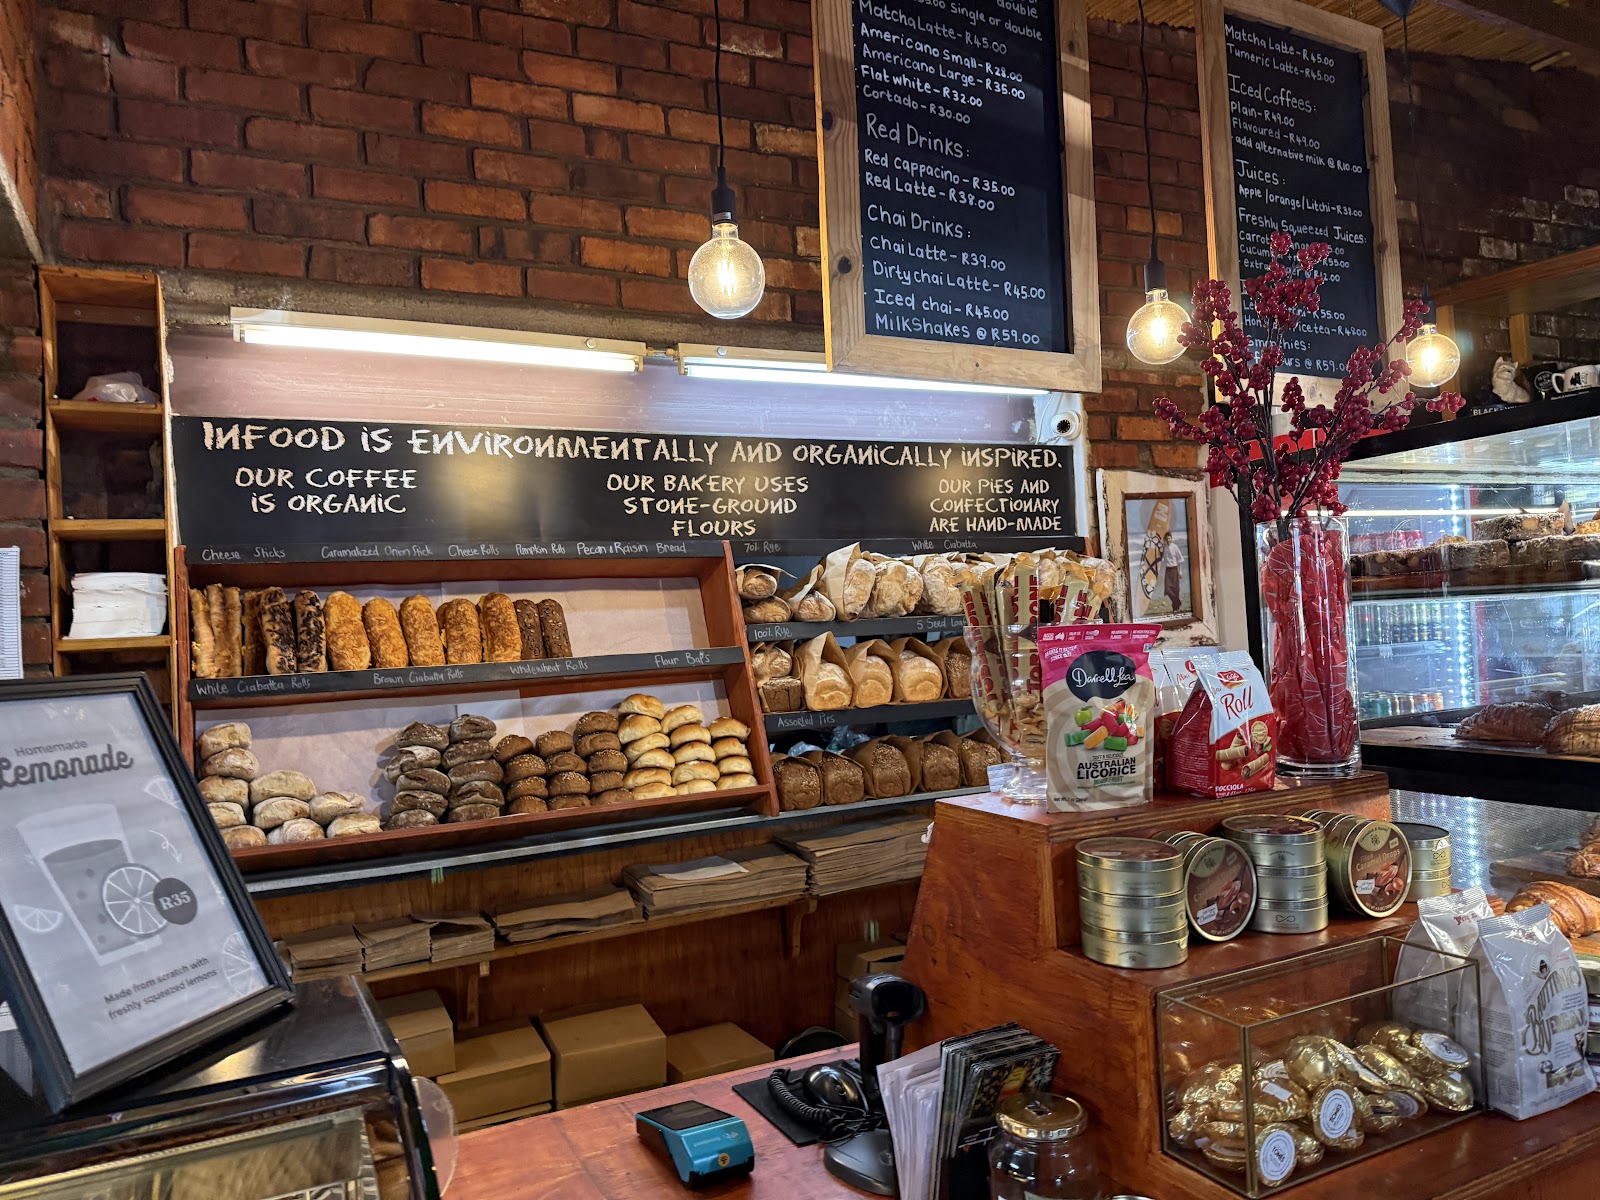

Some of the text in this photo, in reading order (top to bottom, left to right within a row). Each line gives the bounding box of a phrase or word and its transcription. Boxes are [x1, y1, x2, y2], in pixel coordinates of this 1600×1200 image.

[950, 3, 1042, 41] Single or double
[860, 22, 940, 58] Americano
[985, 62, 1023, 83] R28.00
[862, 43, 935, 74] Americano
[985, 79, 1026, 100] R35.00
[860, 64, 890, 84] Flat
[943, 86, 982, 107] R32.00
[1228, 73, 1262, 101] Iced
[929, 102, 971, 125] R30.00
[866, 112, 900, 144] Red
[1232, 119, 1280, 140] Flavoured
[864, 148, 889, 168] Red
[1236, 135, 1253, 148] add
[1255, 141, 1304, 161] alternative
[865, 171, 891, 191] Red
[1236, 158, 1286, 185] Juices:
[1239, 184, 1262, 199] Apple
[867, 204, 907, 228] Chai
[1239, 207, 1367, 244] Freshly Squeezed Juices:
[873, 260, 911, 285] Dirty
[875, 288, 914, 310] Iced
[966, 304, 1009, 322] R45.00
[976, 327, 987, 341] @
[991, 327, 1040, 345] R59.00
[202, 421, 346, 452] INFOOD
[730, 445, 782, 465] AND
[235, 467, 417, 490] OUR COFFEE
[606, 474, 809, 495] OUR BAKERY USES
[939, 480, 972, 495] OUR
[1020, 478, 1050, 495] AND
[624, 496, 798, 515] STONE-GROUND
[671, 519, 757, 537] FLOURS
[929, 518, 1062, 533] ARE HAND-MADE
[384, 546, 410, 557] Onion
[448, 545, 479, 557] Cheese
[577, 544, 607, 555] Pecan
[615, 544, 648, 554] Raisin
[656, 543, 686, 554] Bread
[763, 541, 781, 555] Rye
[912, 539, 934, 550] White
[202, 549, 240, 561] Cheese
[774, 625, 792, 638] Rye
[917, 620, 923, 629] 5
[926, 617, 946, 629] Seed
[565, 659, 588, 671] Rolls
[654, 654, 680, 668] Flour
[196, 677, 311, 697] White Ciabatta Rolls
[373, 672, 404, 685] Brown
[1220, 686, 1253, 720] Roll
[778, 716, 813, 728] Assorted
[15, 740, 88, 757] Homemade
[1077, 765, 1136, 779] LICORICE
[1078, 757, 1136, 769] AUSTRALIAN
[1383, 849, 1400, 861] Drops
[158, 891, 191, 911] R35
[104, 989, 132, 1004] Made
[133, 979, 156, 993] from
[108, 969, 218, 1019] freshly squeezed lemons
